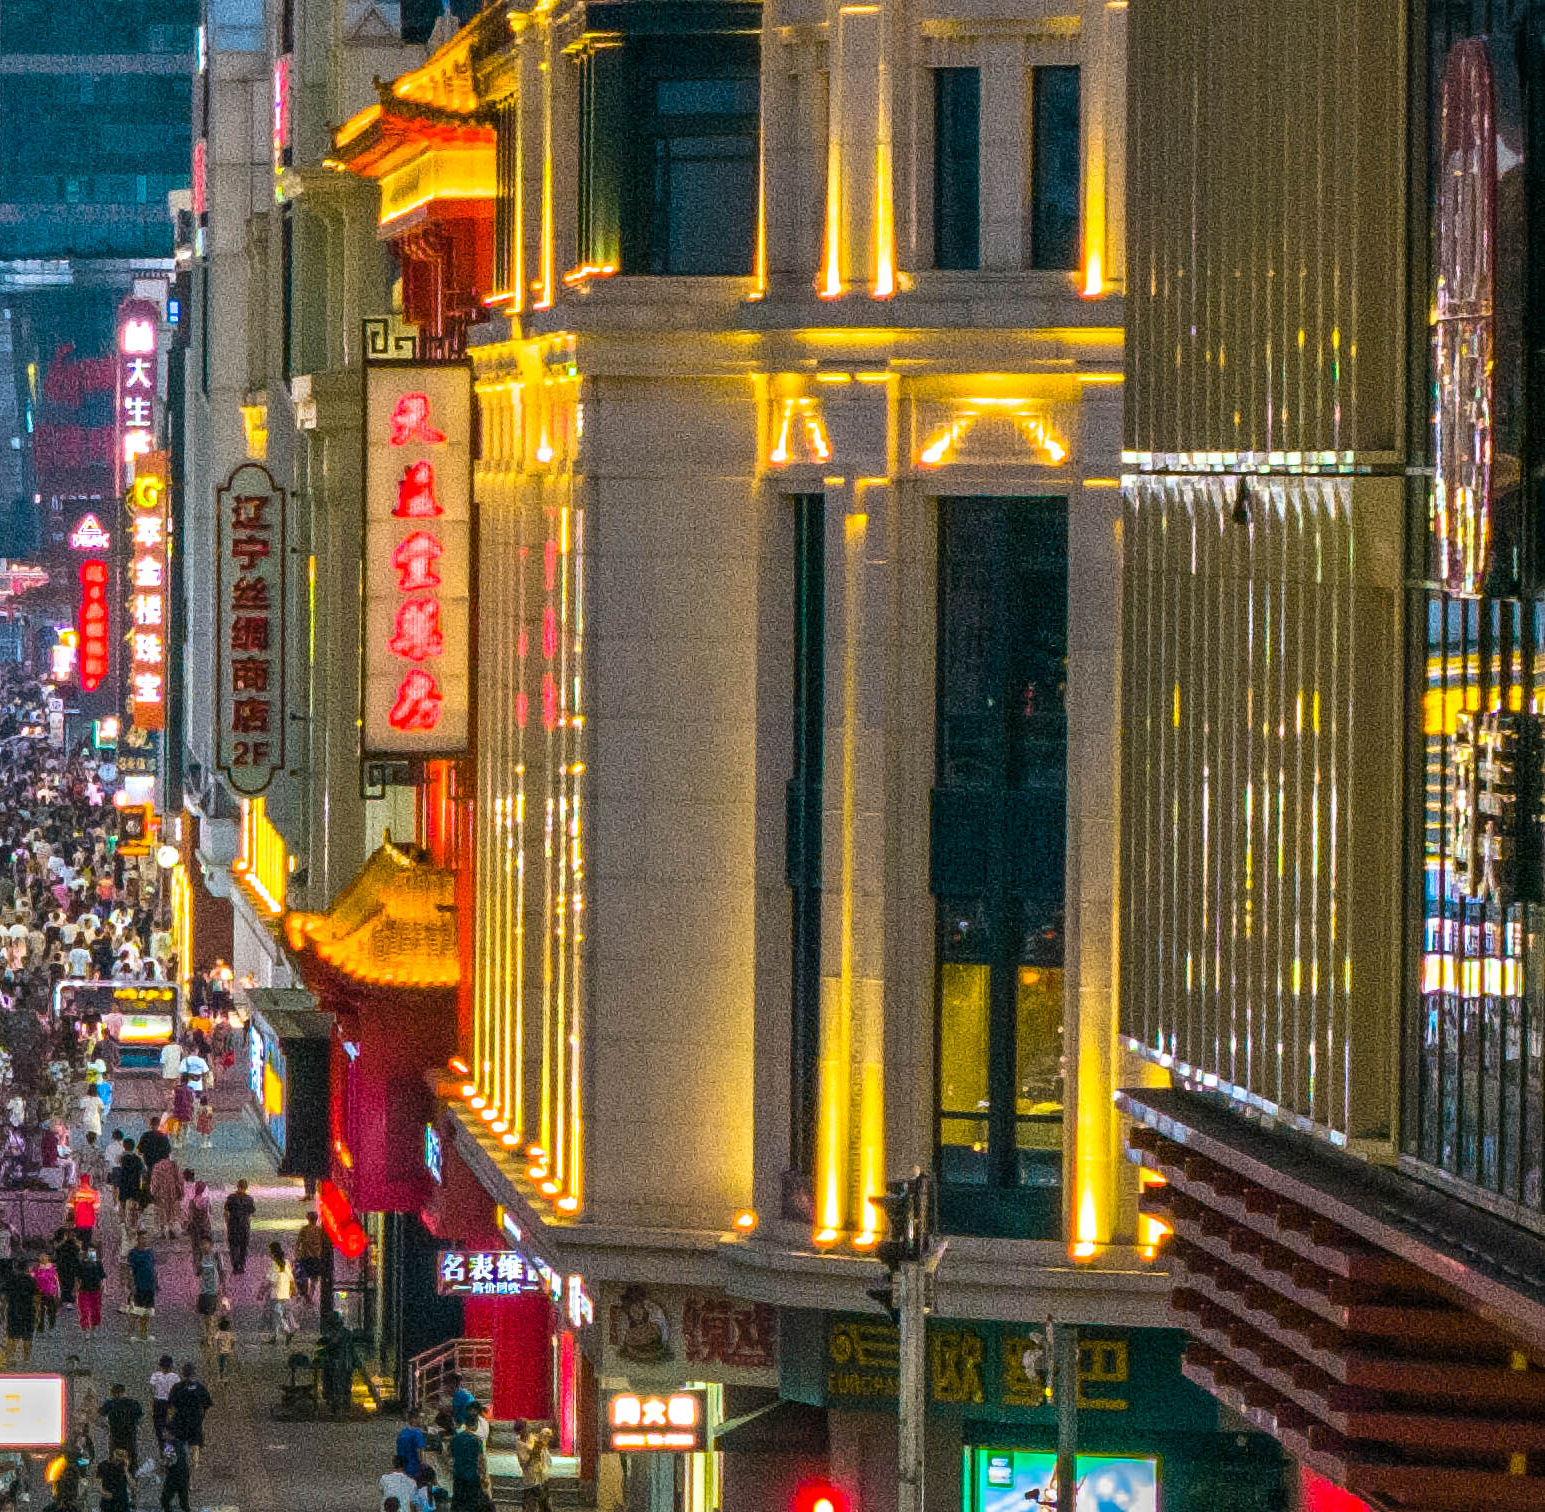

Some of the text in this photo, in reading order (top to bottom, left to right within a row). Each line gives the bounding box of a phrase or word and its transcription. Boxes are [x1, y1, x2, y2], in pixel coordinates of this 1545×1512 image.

[230, 495, 272, 734] 辽宁丝绸商店
[232, 740, 271, 767] 2F
